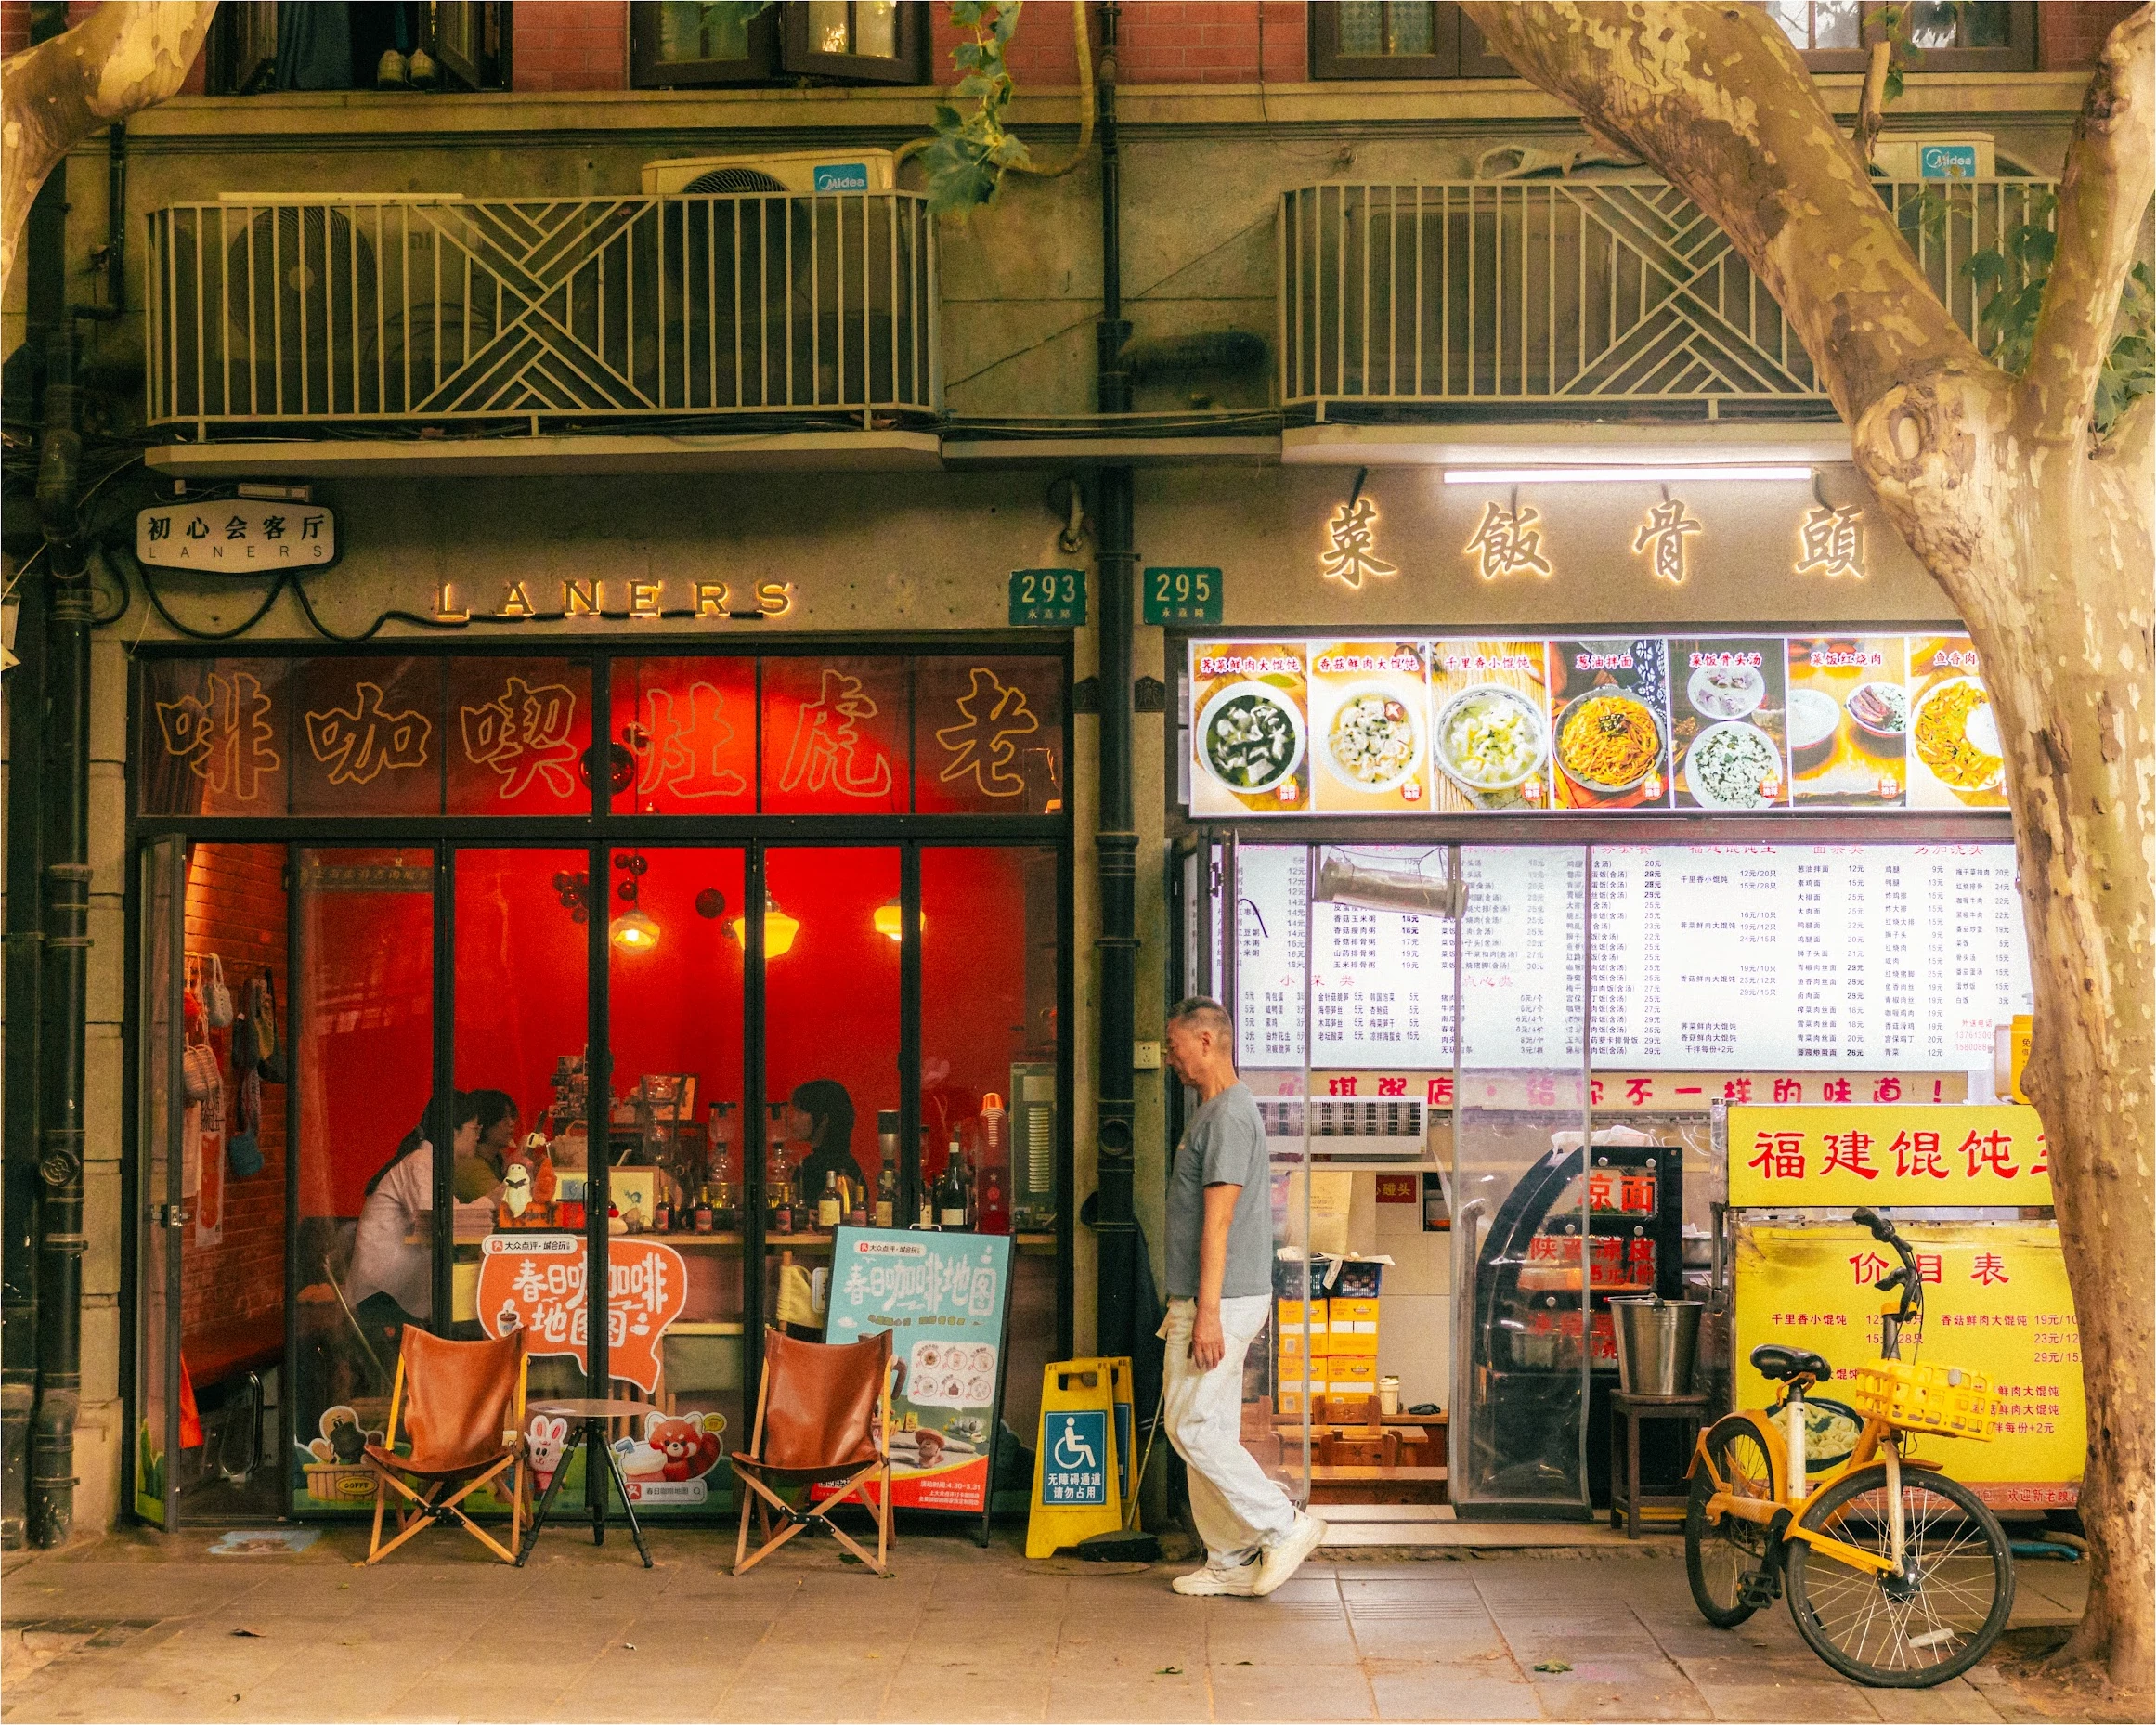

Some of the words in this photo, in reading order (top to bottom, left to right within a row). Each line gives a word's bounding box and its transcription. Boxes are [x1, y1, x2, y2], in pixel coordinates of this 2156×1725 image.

[818, 174, 864, 191] Midea
[147, 513, 325, 542] 初心会客厅
[1323, 499, 1868, 585] 菜飯骨頭
[149, 545, 323, 559] LANERS
[1021, 575, 1076, 603] 293
[1156, 573, 1211, 602] 295
[437, 580, 792, 617] LANERS
[1027, 609, 1071, 619] 永嘉路
[1162, 607, 1204, 617] 永嘉路
[1201, 658, 1301, 673] 荠菜鲜肉大馄饨
[1319, 658, 1420, 672] 香菇鲜肉大馄饨
[1446, 657, 1530, 670] 千里香小馄饨
[1571, 654, 1633, 668] 葱油拌面
[1689, 653, 1762, 668] 菜饭骨头汤
[1811, 653, 1882, 667] 菜饭红烧肉
[1376, 1183, 1410, 1197] 碰头
[1849, 1252, 2009, 1286] 价目表
[1772, 1314, 1848, 1326] 千里香小馄饨
[1942, 1314, 2028, 1327] 香菇鲜肉大馄饨
[1048, 1473, 1101, 1486] 无障碍通道
[1053, 1486, 1096, 1499] 请勿占用
